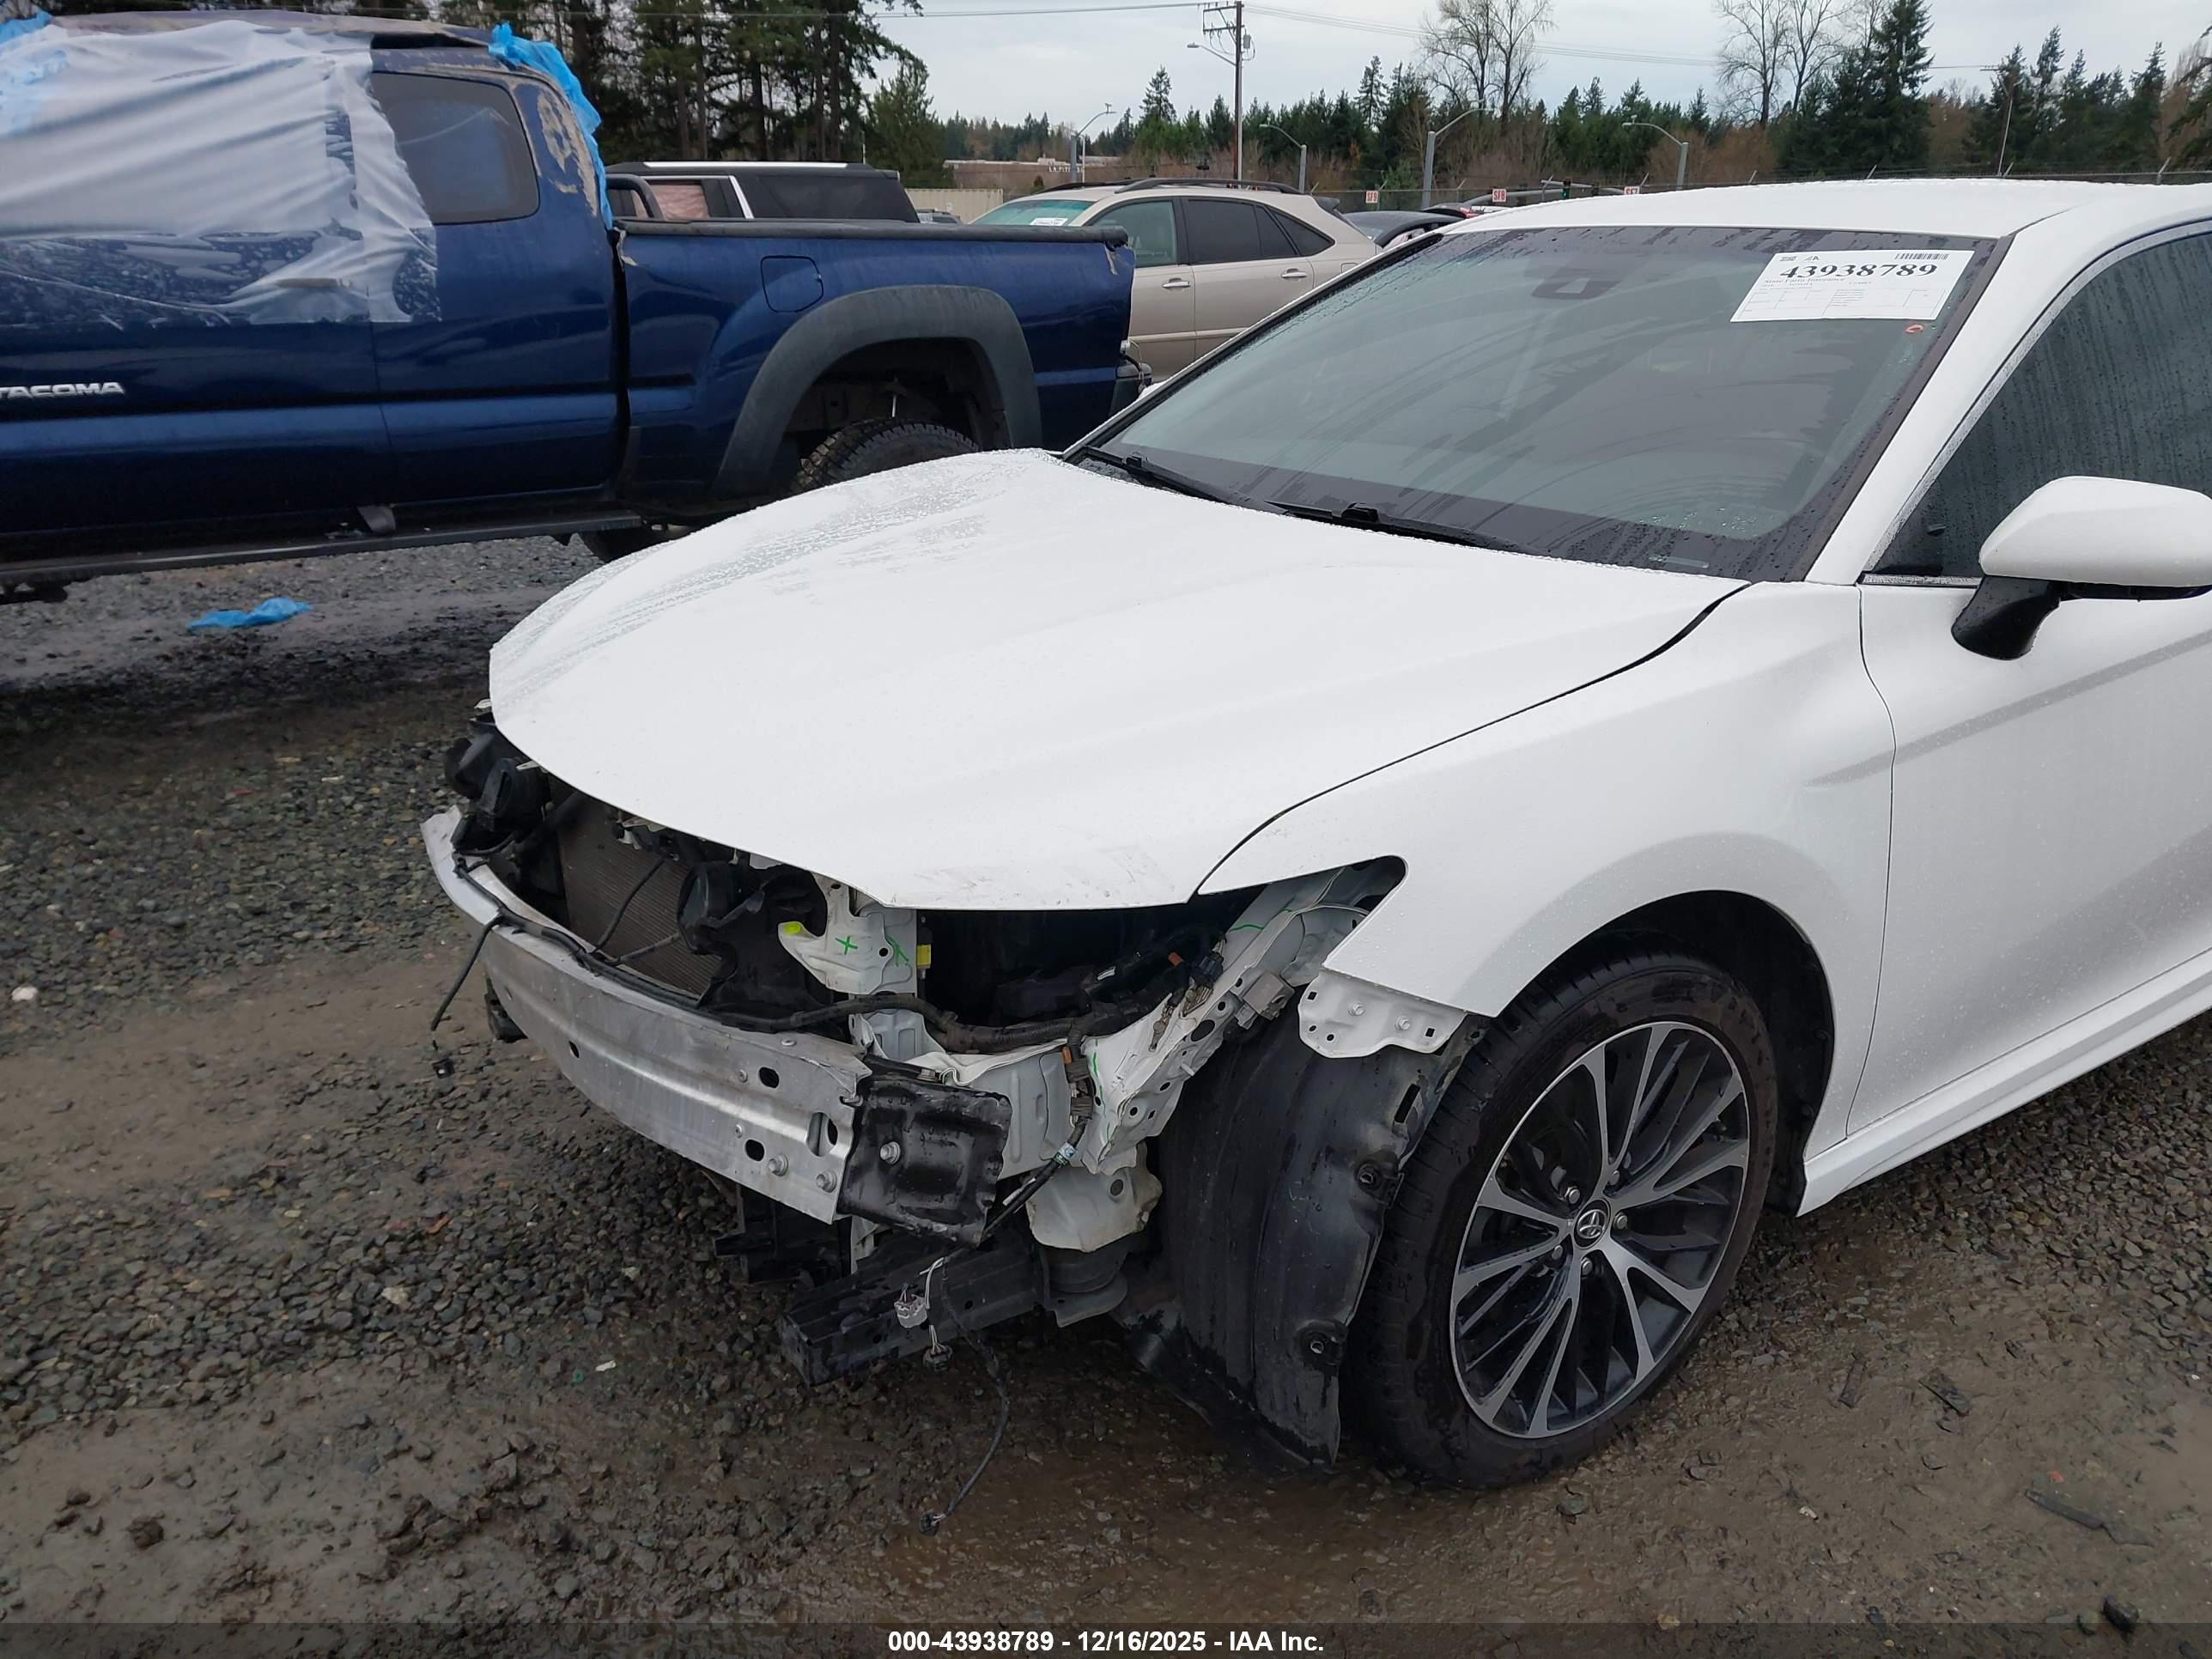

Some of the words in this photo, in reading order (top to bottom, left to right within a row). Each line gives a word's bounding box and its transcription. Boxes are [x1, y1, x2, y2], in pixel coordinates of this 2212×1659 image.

[1367, 191, 1377, 202] SF9
[1494, 190, 1505, 201] SF8
[1779, 264, 1938, 278] 43938789
